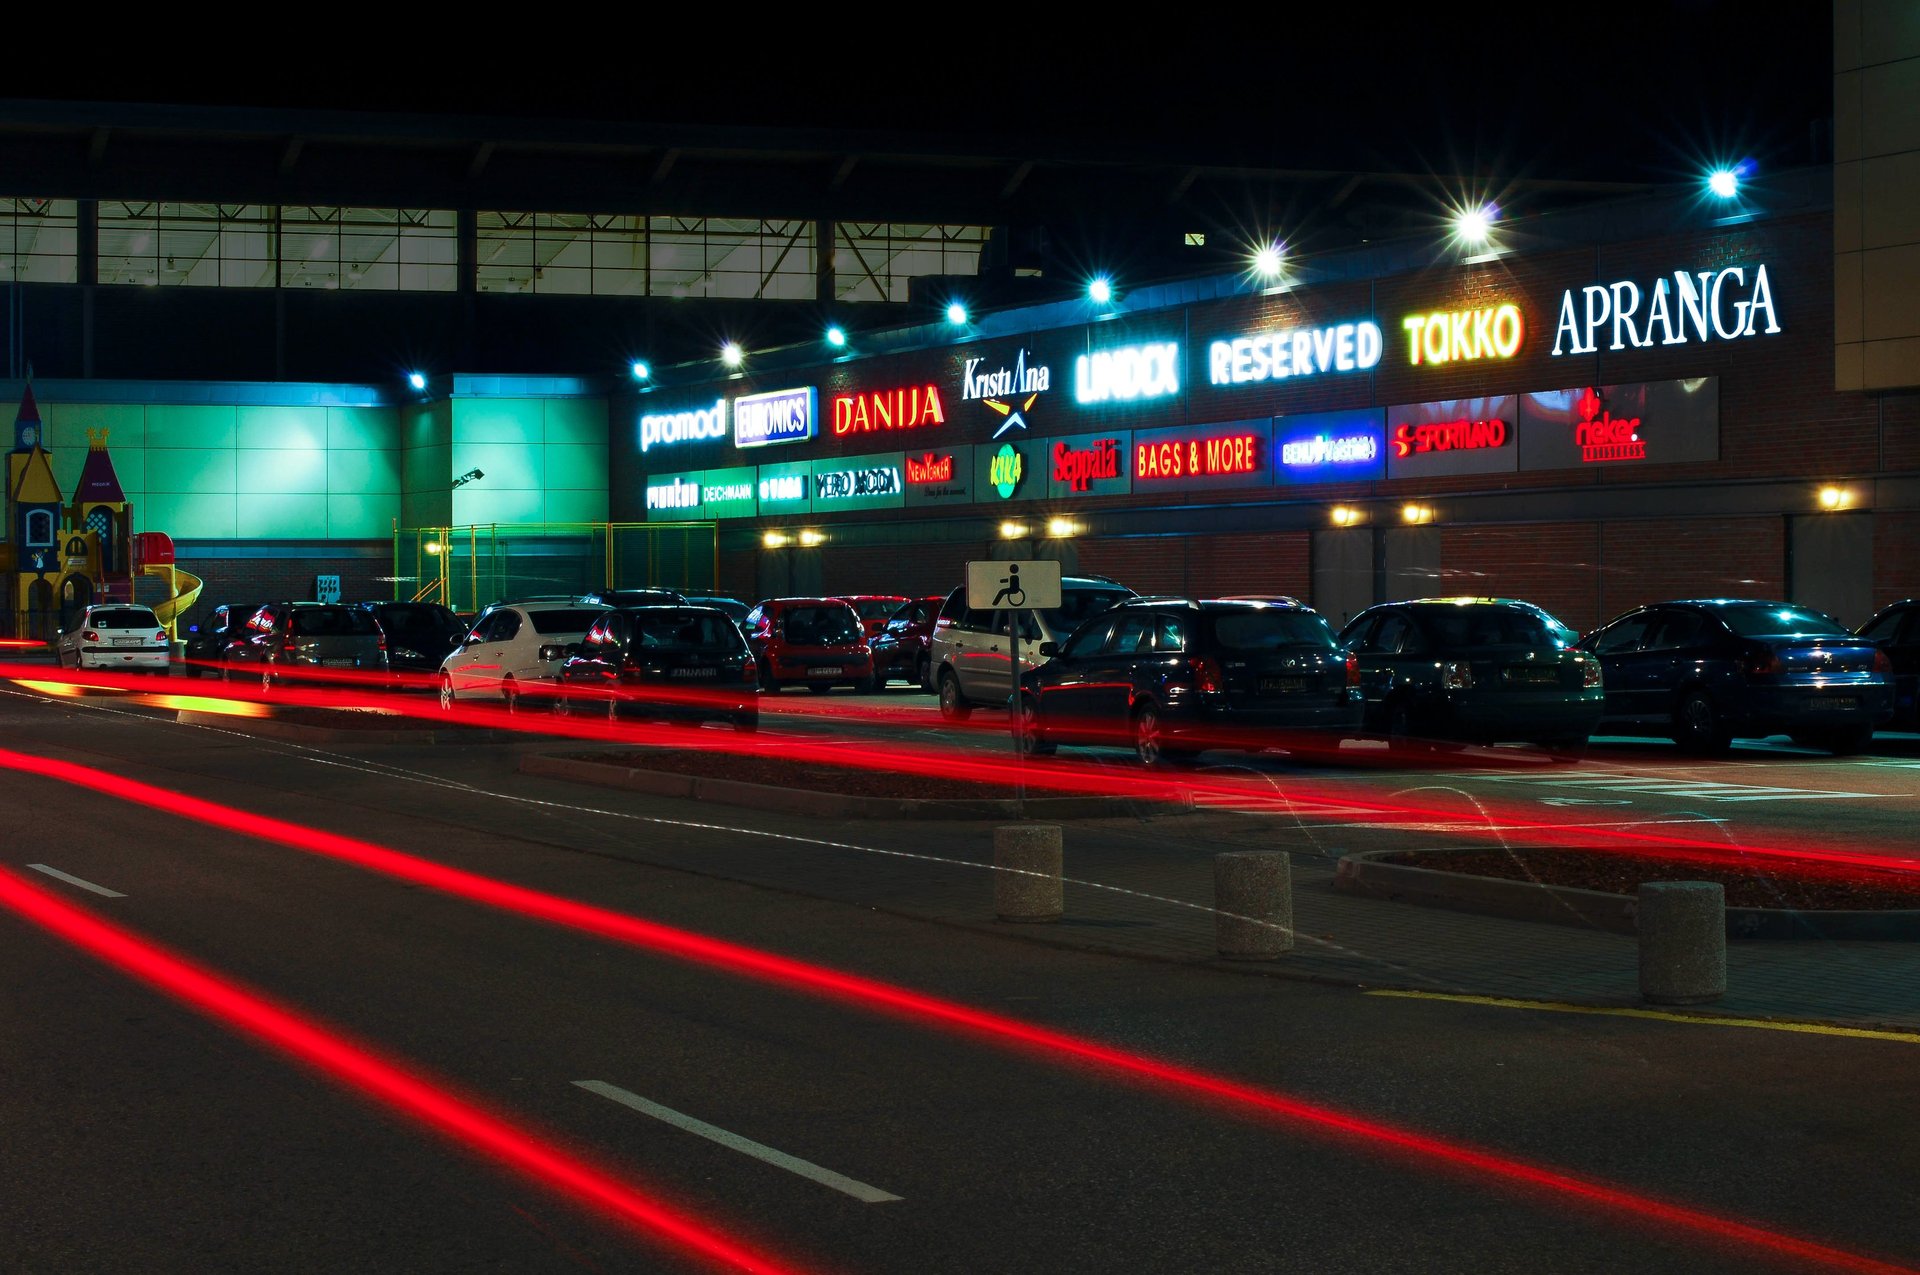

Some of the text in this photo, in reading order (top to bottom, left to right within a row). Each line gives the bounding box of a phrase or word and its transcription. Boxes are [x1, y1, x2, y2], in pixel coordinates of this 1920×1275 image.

[1551, 263, 1781, 356] APRANGA
[1209, 321, 1383, 385] RESERVED
[642, 399, 726, 453] promod
[738, 396, 805, 438] EURONICS
[834, 386, 945, 436] DANIJA
[1413, 418, 1507, 452] SPORTLAND
[1053, 438, 1117, 492] Seppälä
[1137, 436, 1256, 478] BAGS & MORE
[703, 484, 753, 503] DEICHMANN
